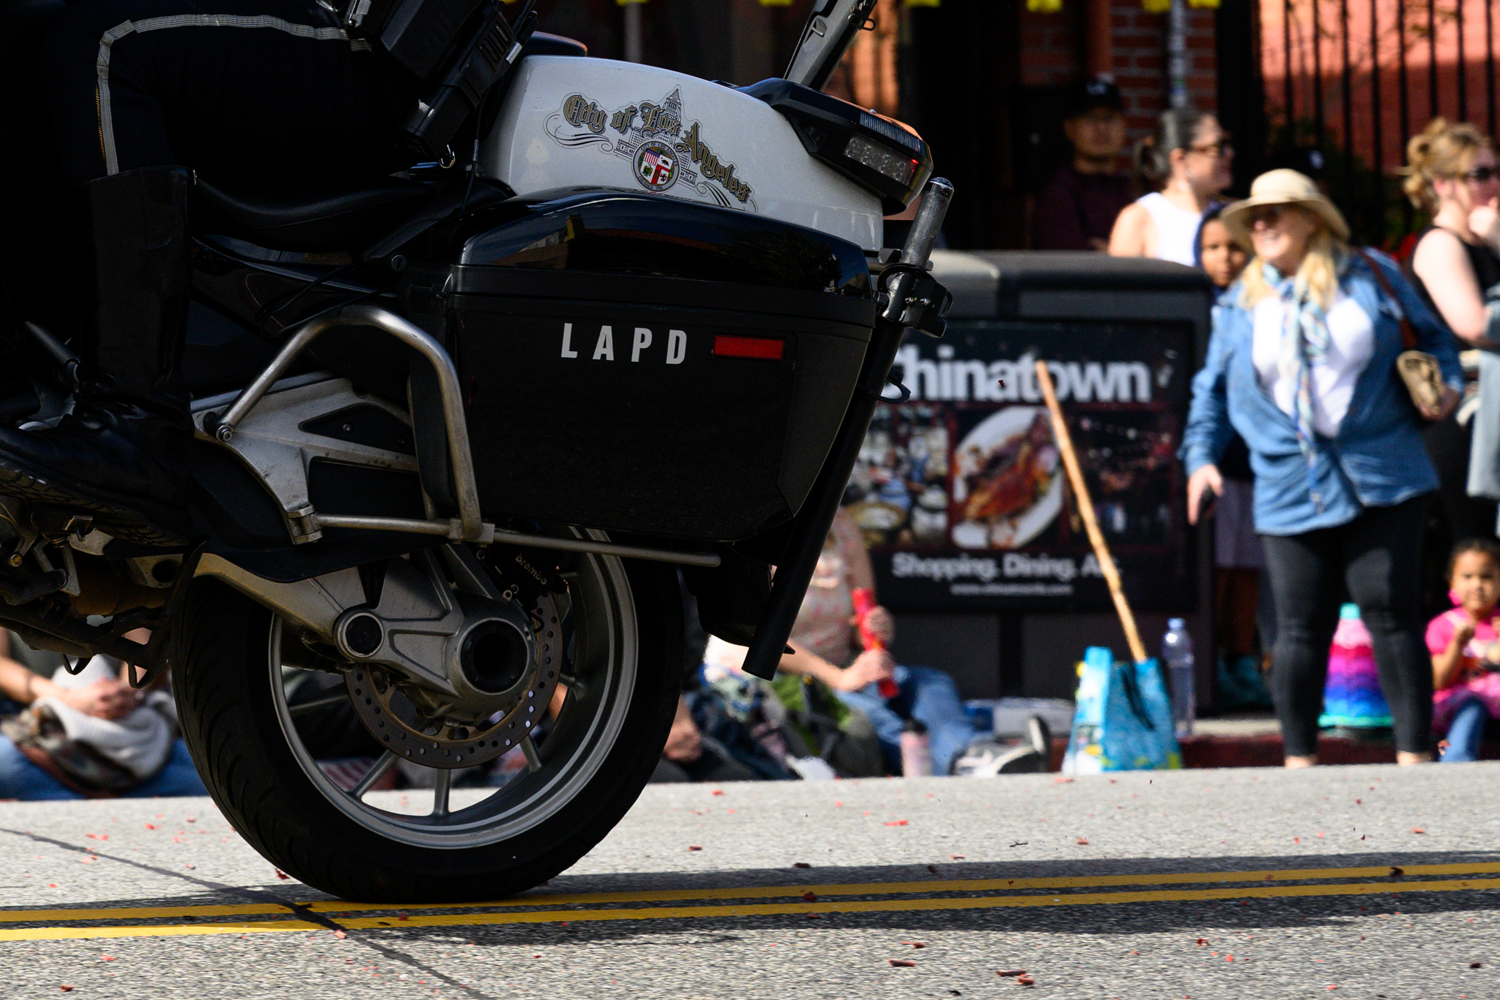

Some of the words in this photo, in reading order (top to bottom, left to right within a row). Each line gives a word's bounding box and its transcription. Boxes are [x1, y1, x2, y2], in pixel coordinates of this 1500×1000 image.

[562, 94, 609, 135] City
[609, 105, 638, 135] of
[639, 101, 683, 138] Los
[675, 120, 753, 203] Angeles
[560, 322, 688, 365] LAPD
[515, 553, 548, 586] brembo
